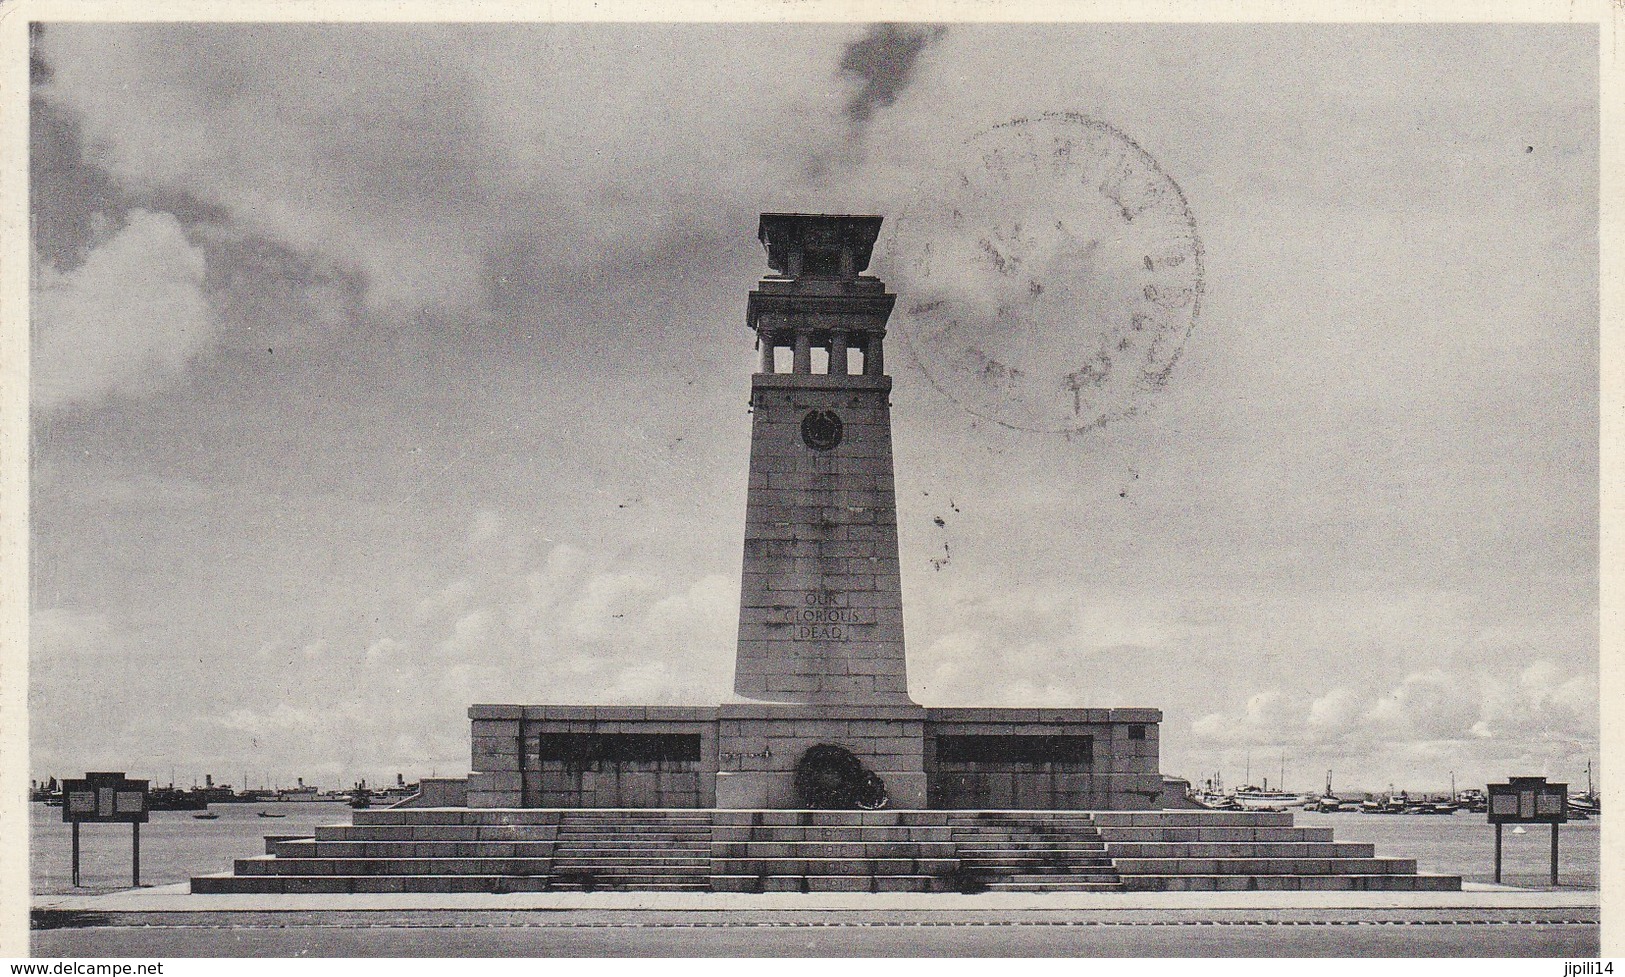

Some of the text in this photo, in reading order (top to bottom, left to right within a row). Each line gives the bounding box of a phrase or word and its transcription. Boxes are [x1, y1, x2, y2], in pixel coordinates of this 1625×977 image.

[805, 593, 838, 605] OUR
[786, 610, 859, 622] GLORIOUS
[800, 626, 841, 639] DEAD
